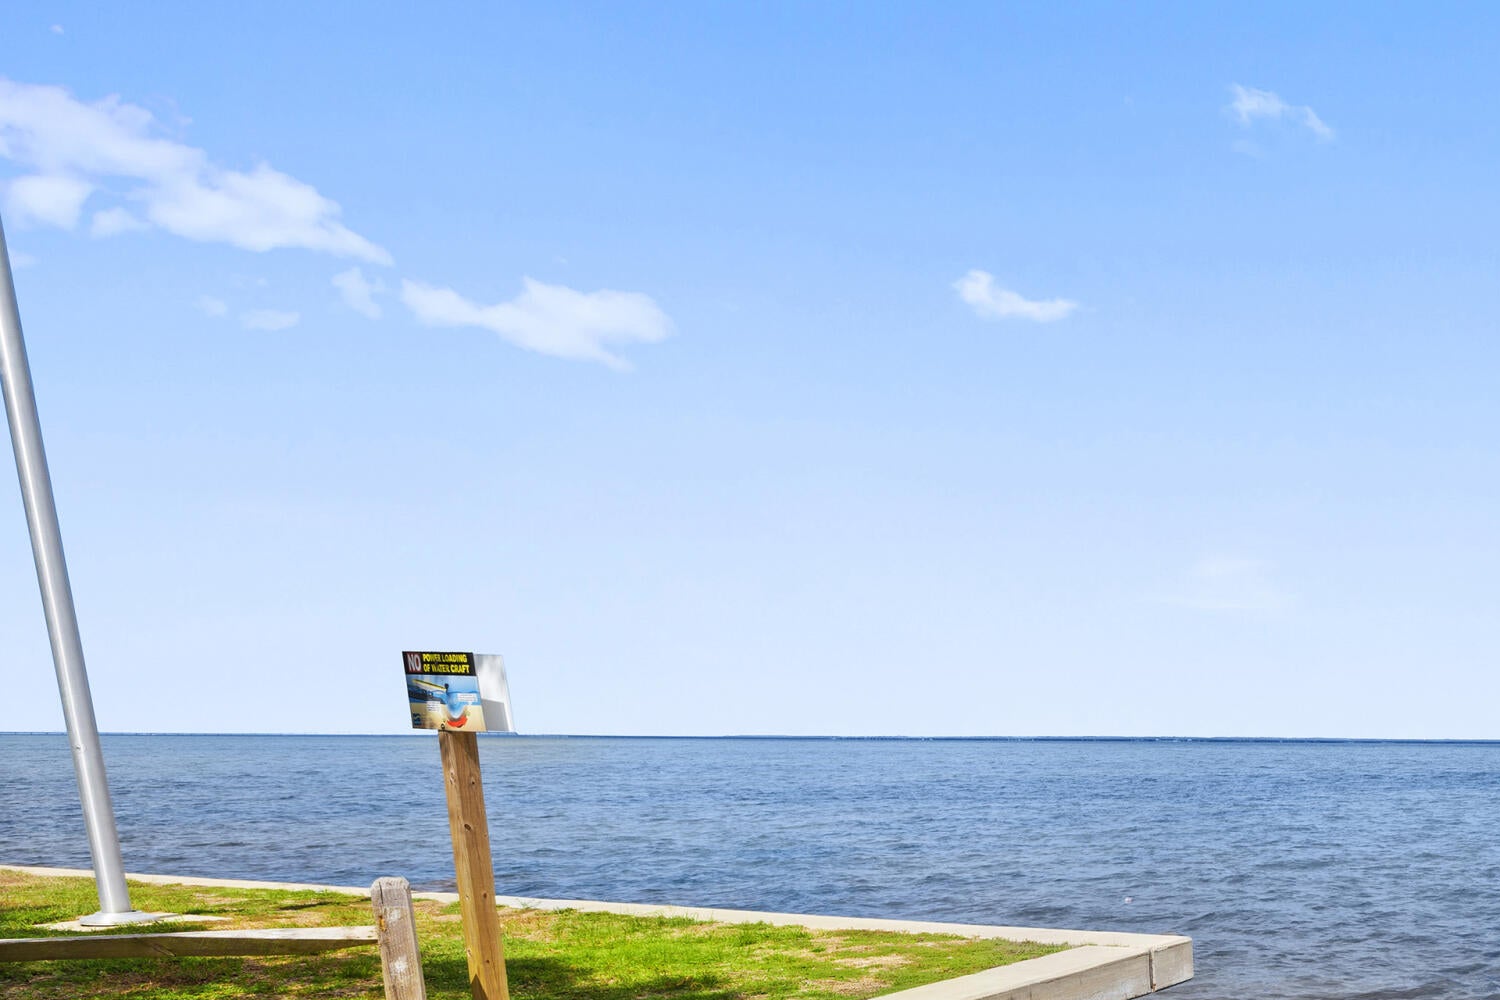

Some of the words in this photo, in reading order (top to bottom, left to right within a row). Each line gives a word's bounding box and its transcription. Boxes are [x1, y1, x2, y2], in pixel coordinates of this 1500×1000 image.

[408, 654, 421, 671] NO
[423, 654, 441, 662] POWER
[442, 654, 467, 663] LOADING
[423, 664, 431, 672] OF
[431, 664, 450, 673] WATER
[450, 664, 470, 674] CRAFT
